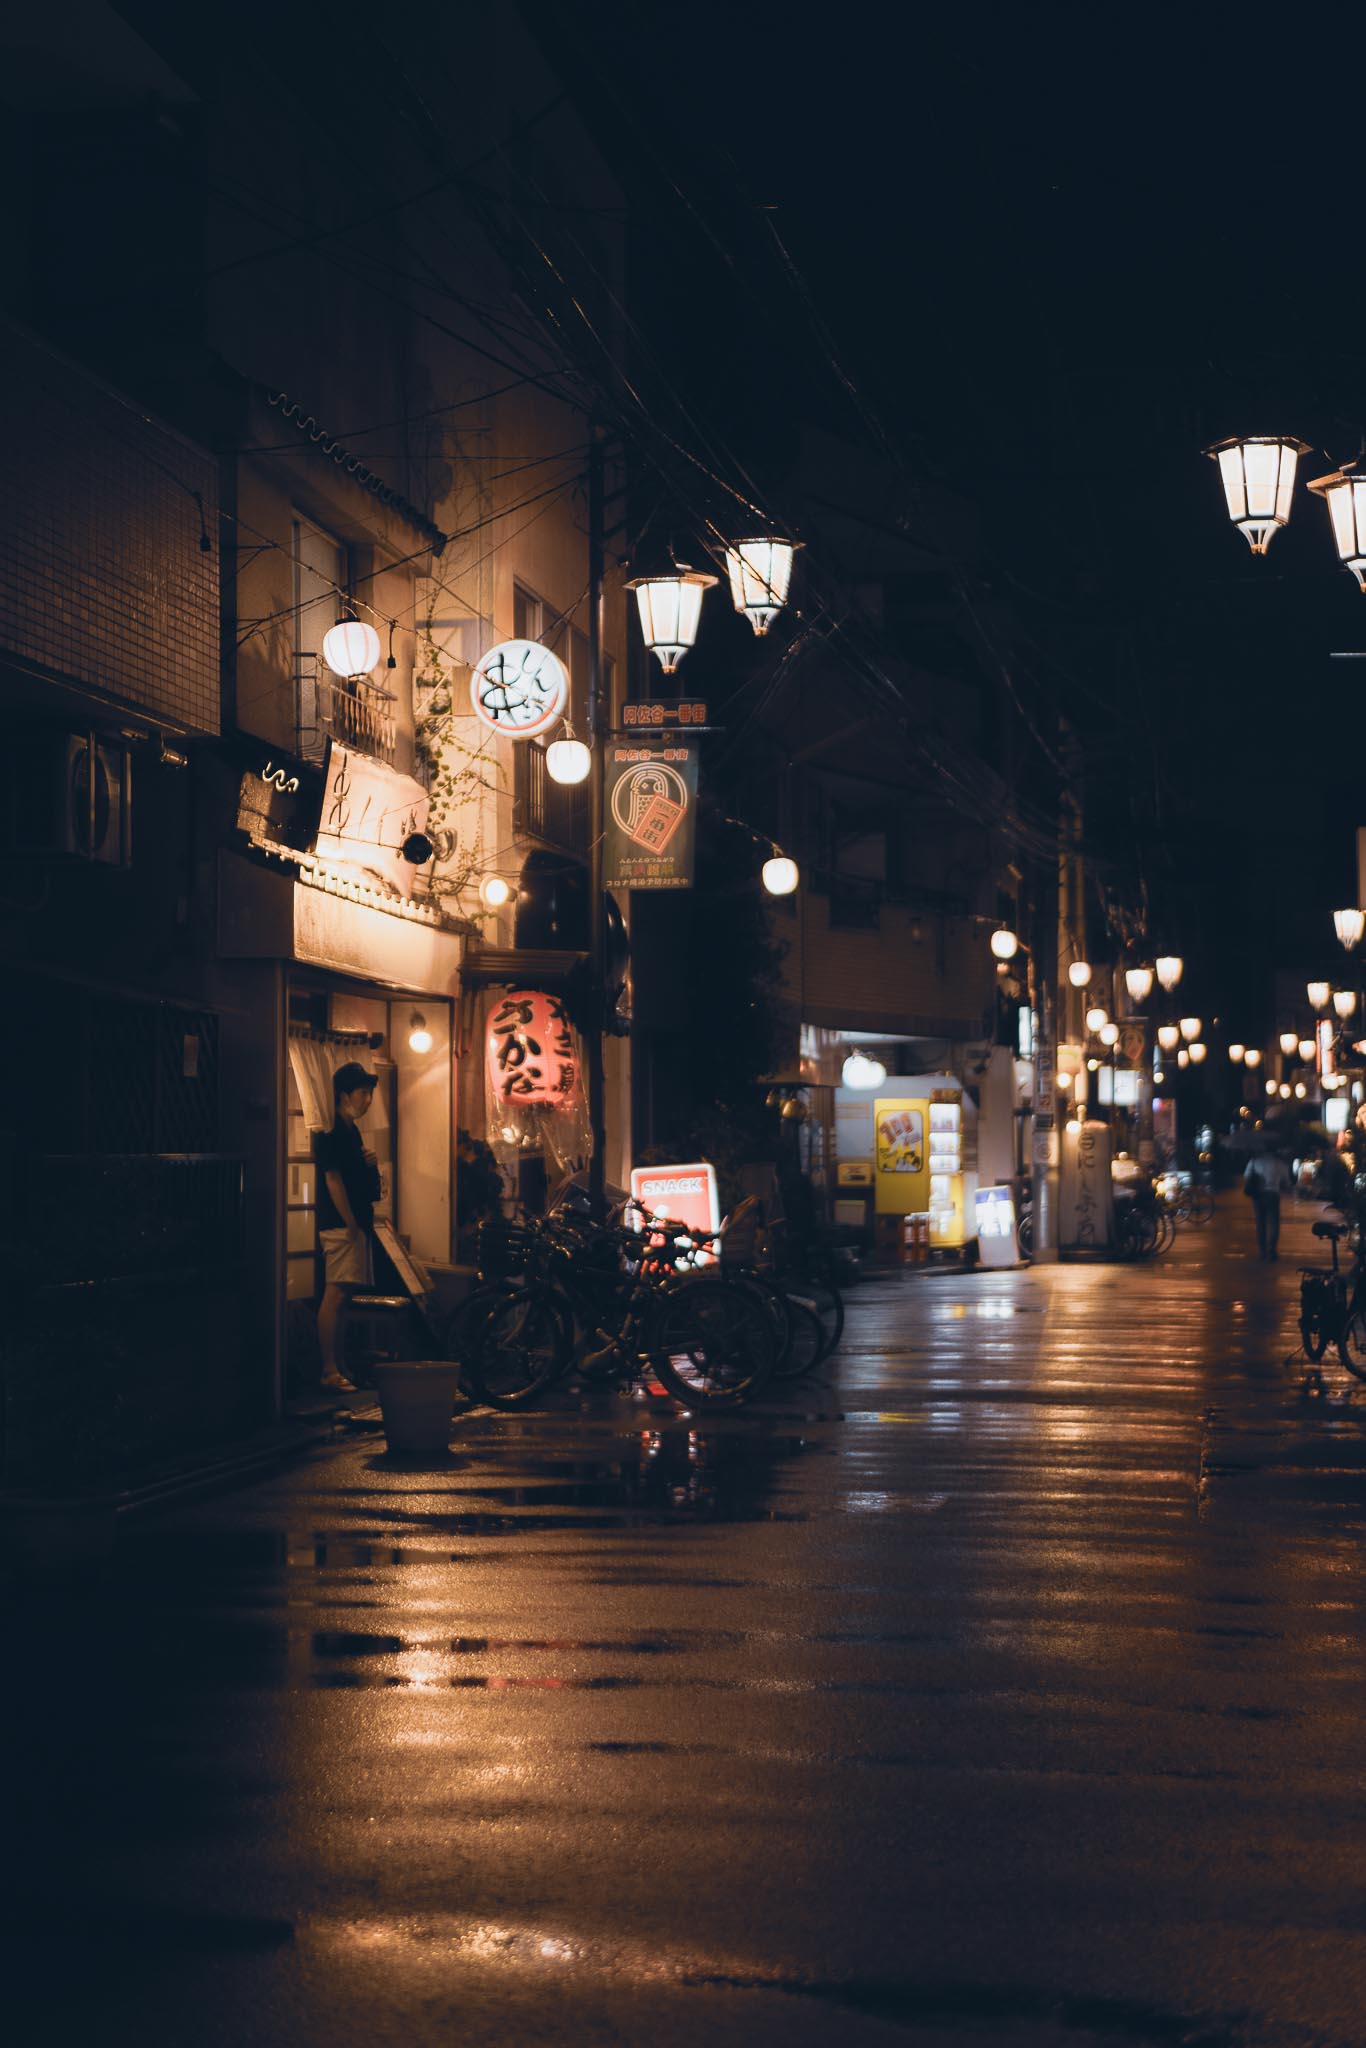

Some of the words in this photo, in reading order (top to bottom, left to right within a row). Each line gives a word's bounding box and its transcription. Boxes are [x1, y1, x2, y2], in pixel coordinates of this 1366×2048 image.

[624, 704, 706, 724] 阿佐谷一番街
[614, 749, 688, 761] 阿佐谷一番街
[643, 1178, 702, 1194] SNACK
